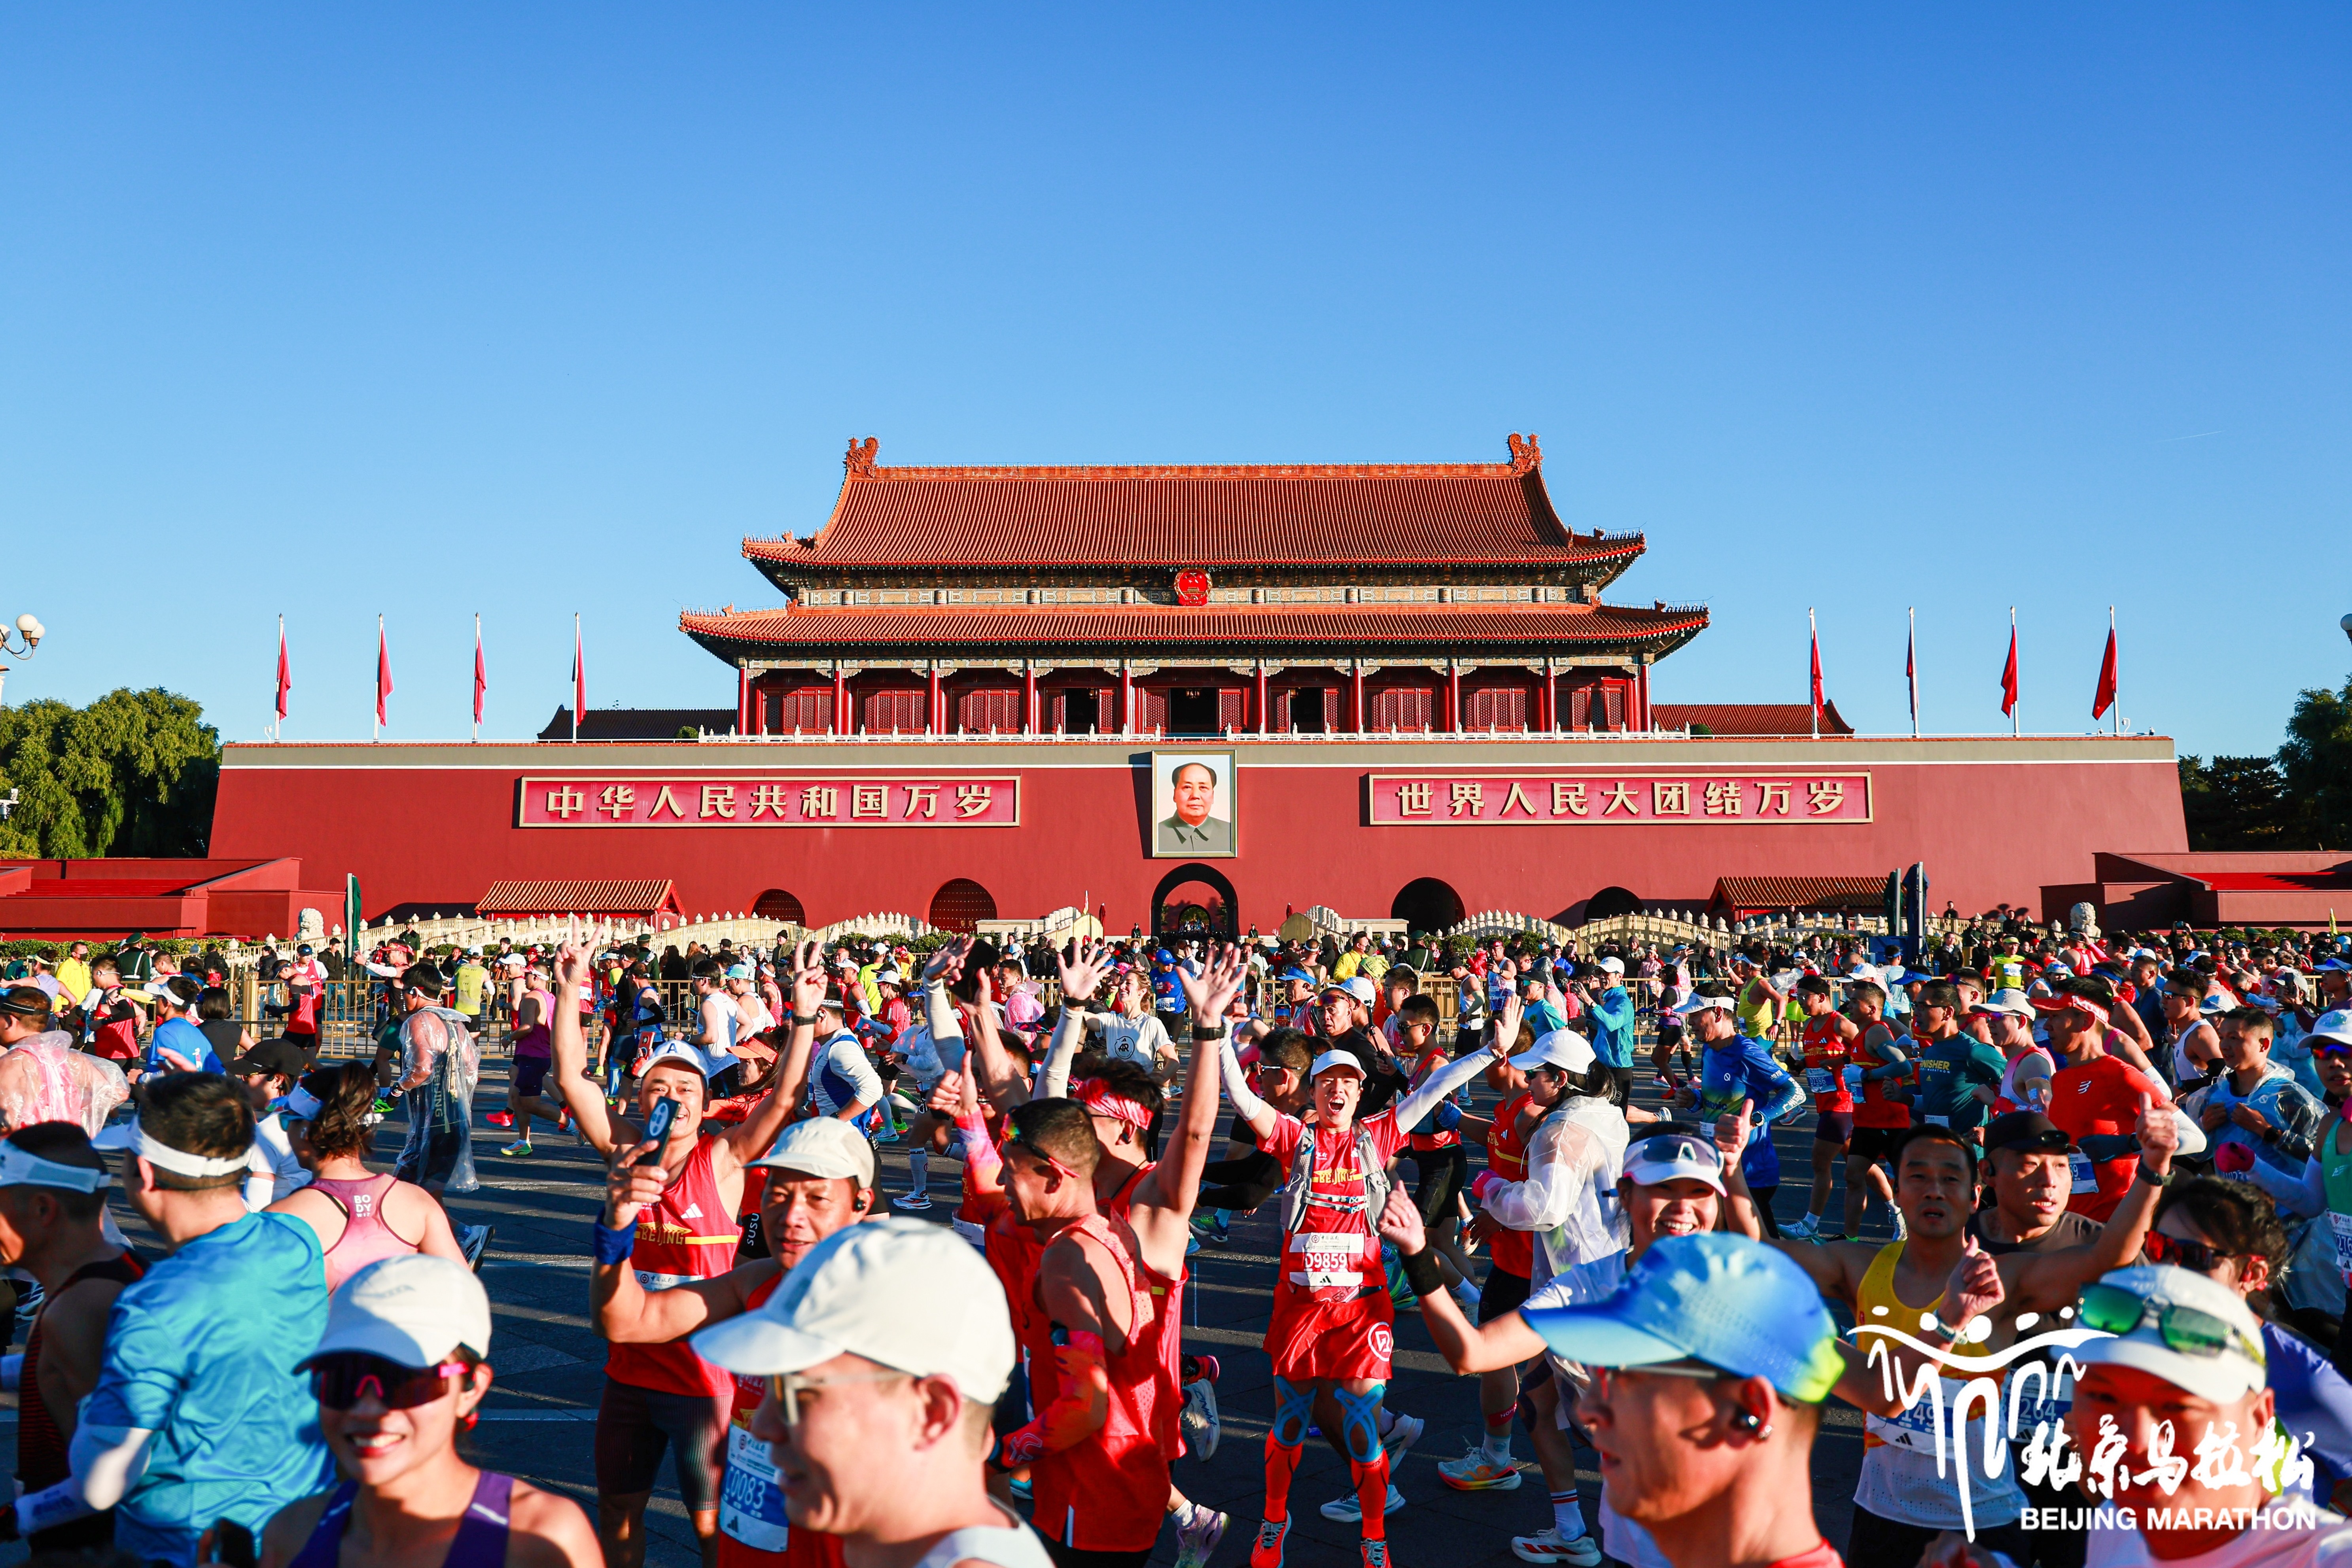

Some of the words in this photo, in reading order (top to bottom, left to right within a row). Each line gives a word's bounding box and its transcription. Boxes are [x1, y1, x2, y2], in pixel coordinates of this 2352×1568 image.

[546, 785, 994, 819] 中华人民共和国万岁
[1397, 782, 1846, 816] 世界人民大团结万岁
[667, 1043, 677, 1053] A
[1318, 1169, 1354, 1185] BEIJING
[640, 1225, 685, 1246] BEIJING
[1305, 1252, 1348, 1269] D9859
[2020, 1398, 2057, 1422] 264
